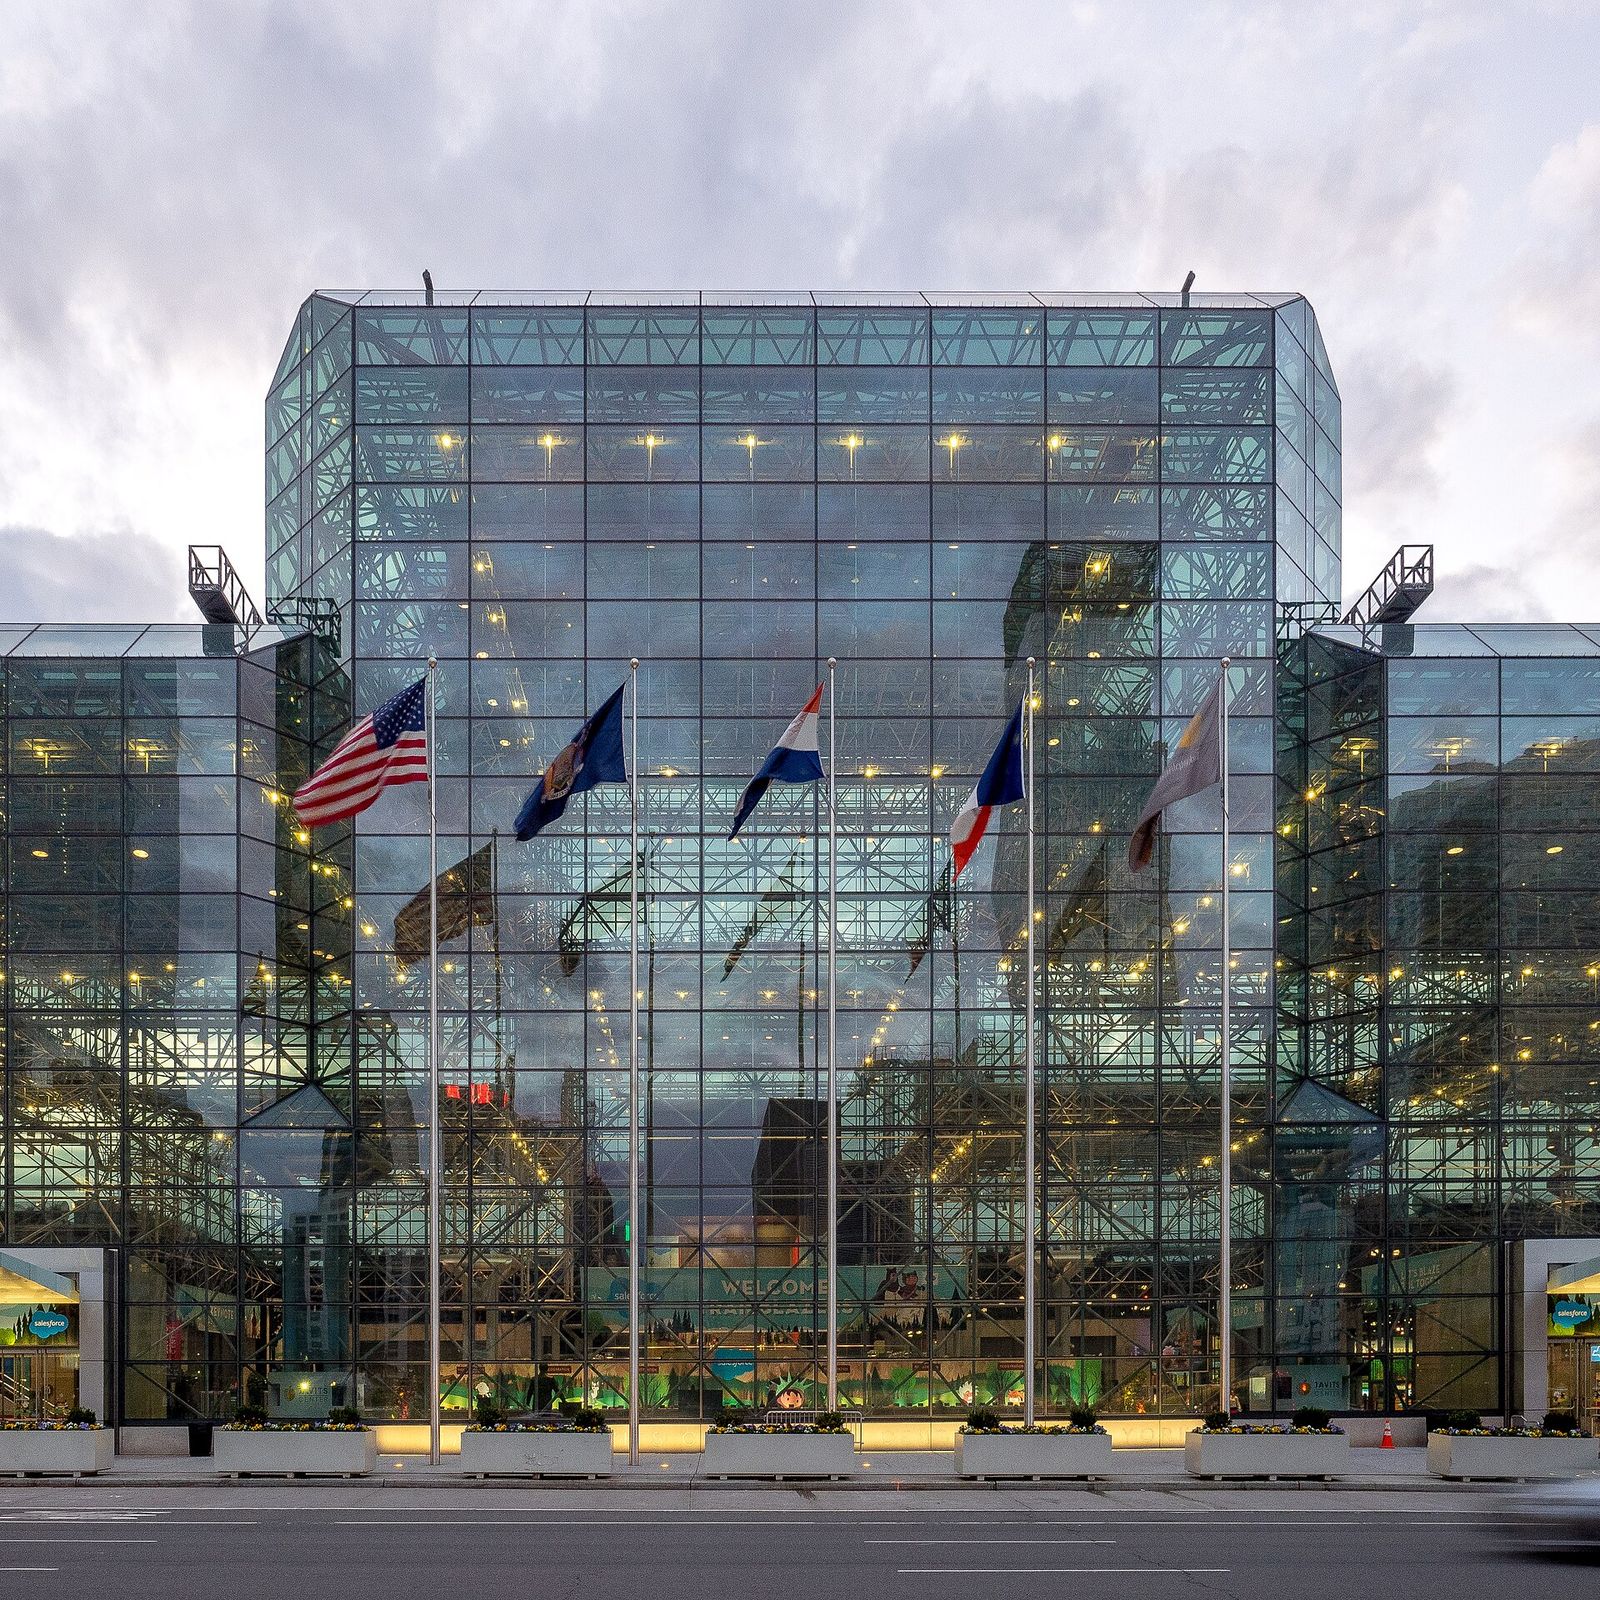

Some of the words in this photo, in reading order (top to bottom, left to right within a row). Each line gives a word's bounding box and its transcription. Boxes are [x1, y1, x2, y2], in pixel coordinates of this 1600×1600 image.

[721, 1279, 828, 1295] WELCOME
[1557, 1309, 1588, 1318] salesforce
[34, 1319, 65, 1328] salesforce
